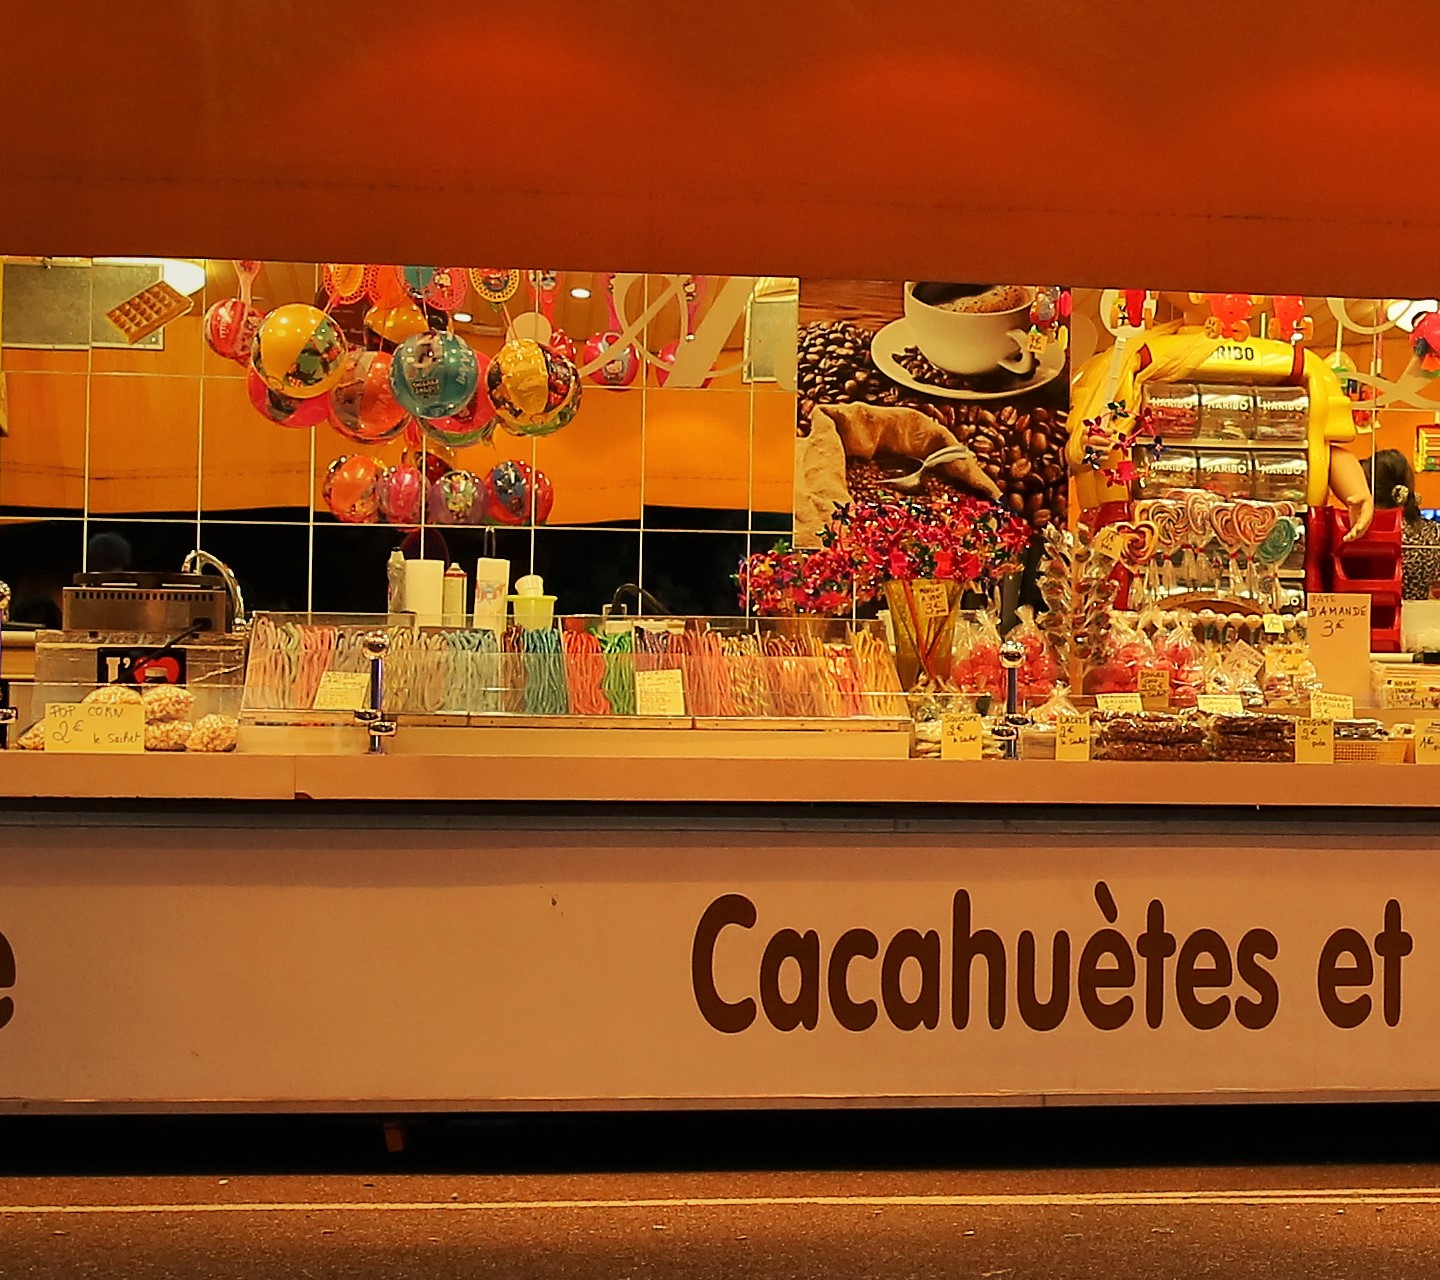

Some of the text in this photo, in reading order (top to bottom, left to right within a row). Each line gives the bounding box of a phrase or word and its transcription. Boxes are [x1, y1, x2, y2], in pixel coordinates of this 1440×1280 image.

[1151, 398, 1193, 409] HARIBO
[1207, 400, 1249, 411] HARIBO
[1262, 401, 1304, 411] HARIBO
[1150, 461, 1192, 472] HARIBO
[1205, 463, 1247, 474] HARIBO
[1261, 464, 1303, 475] HARIBO
[1310, 605, 1367, 618] D'AMANDE
[49, 705, 124, 718] POP CORN
[52, 719, 85, 744] 2€
[691, 880, 1281, 1034] Cacahuètes
[1317, 898, 1414, 1029] et
